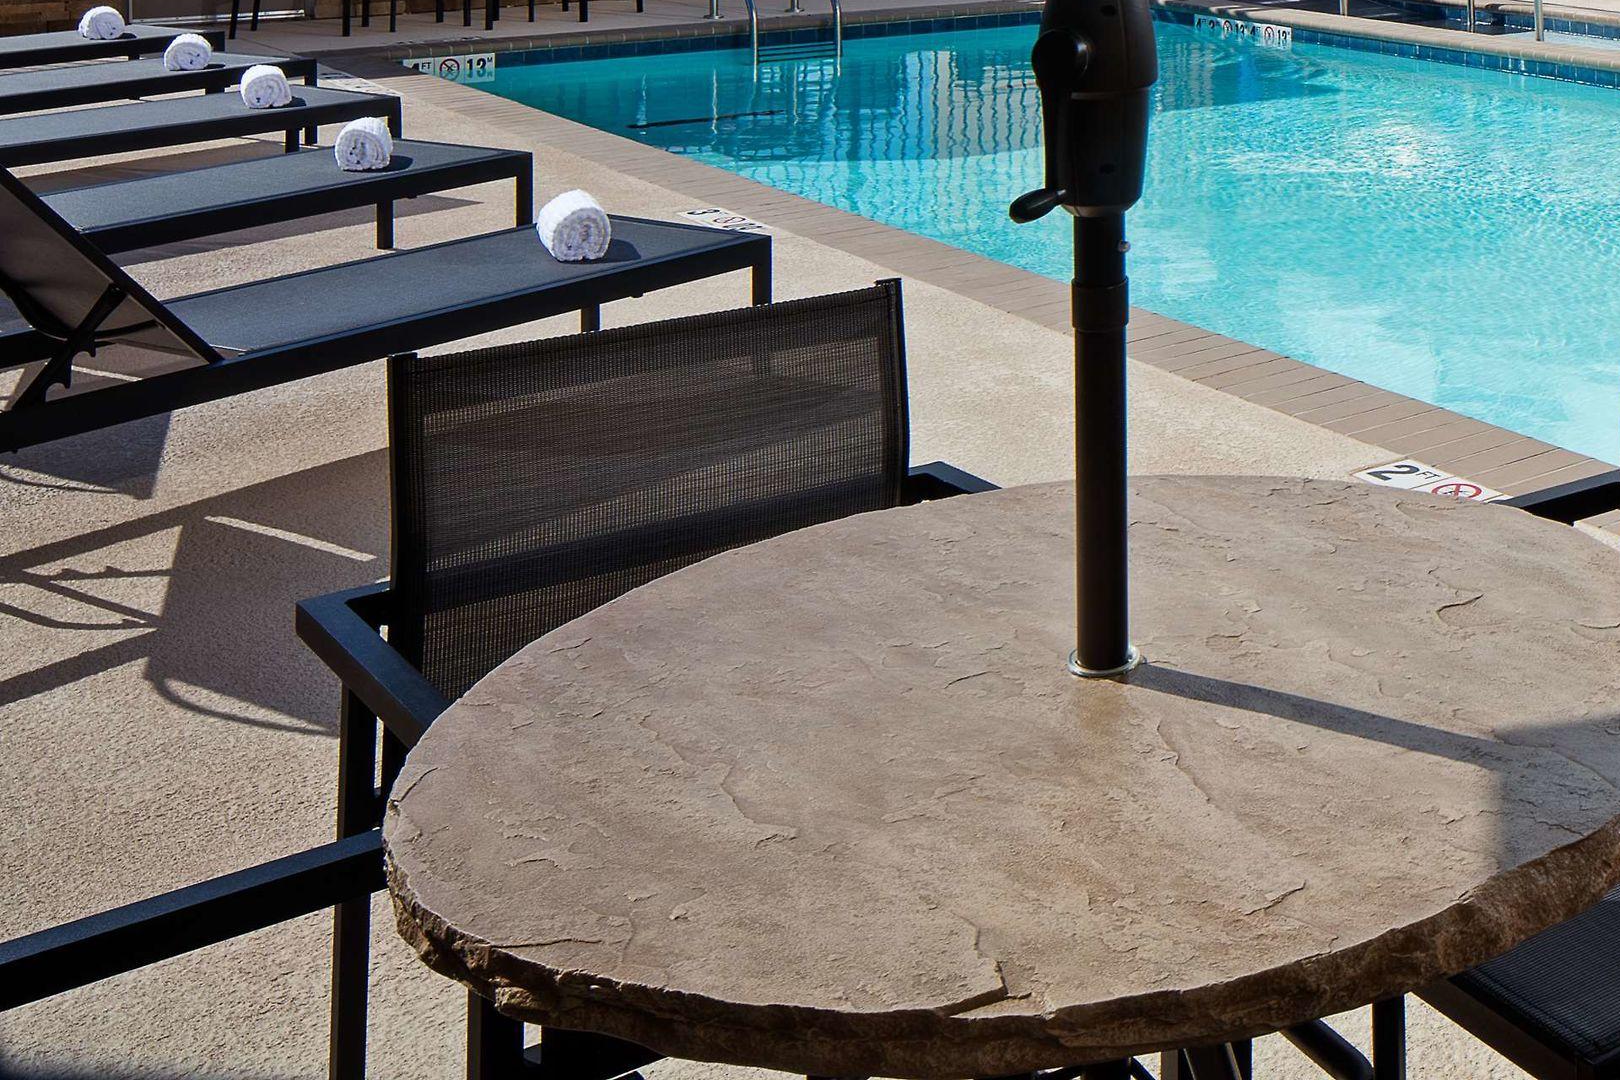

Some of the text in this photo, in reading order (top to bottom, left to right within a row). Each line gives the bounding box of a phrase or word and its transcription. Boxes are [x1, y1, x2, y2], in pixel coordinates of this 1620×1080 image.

[421, 62, 432, 70] FT
[1366, 464, 1442, 482] 2 FT
